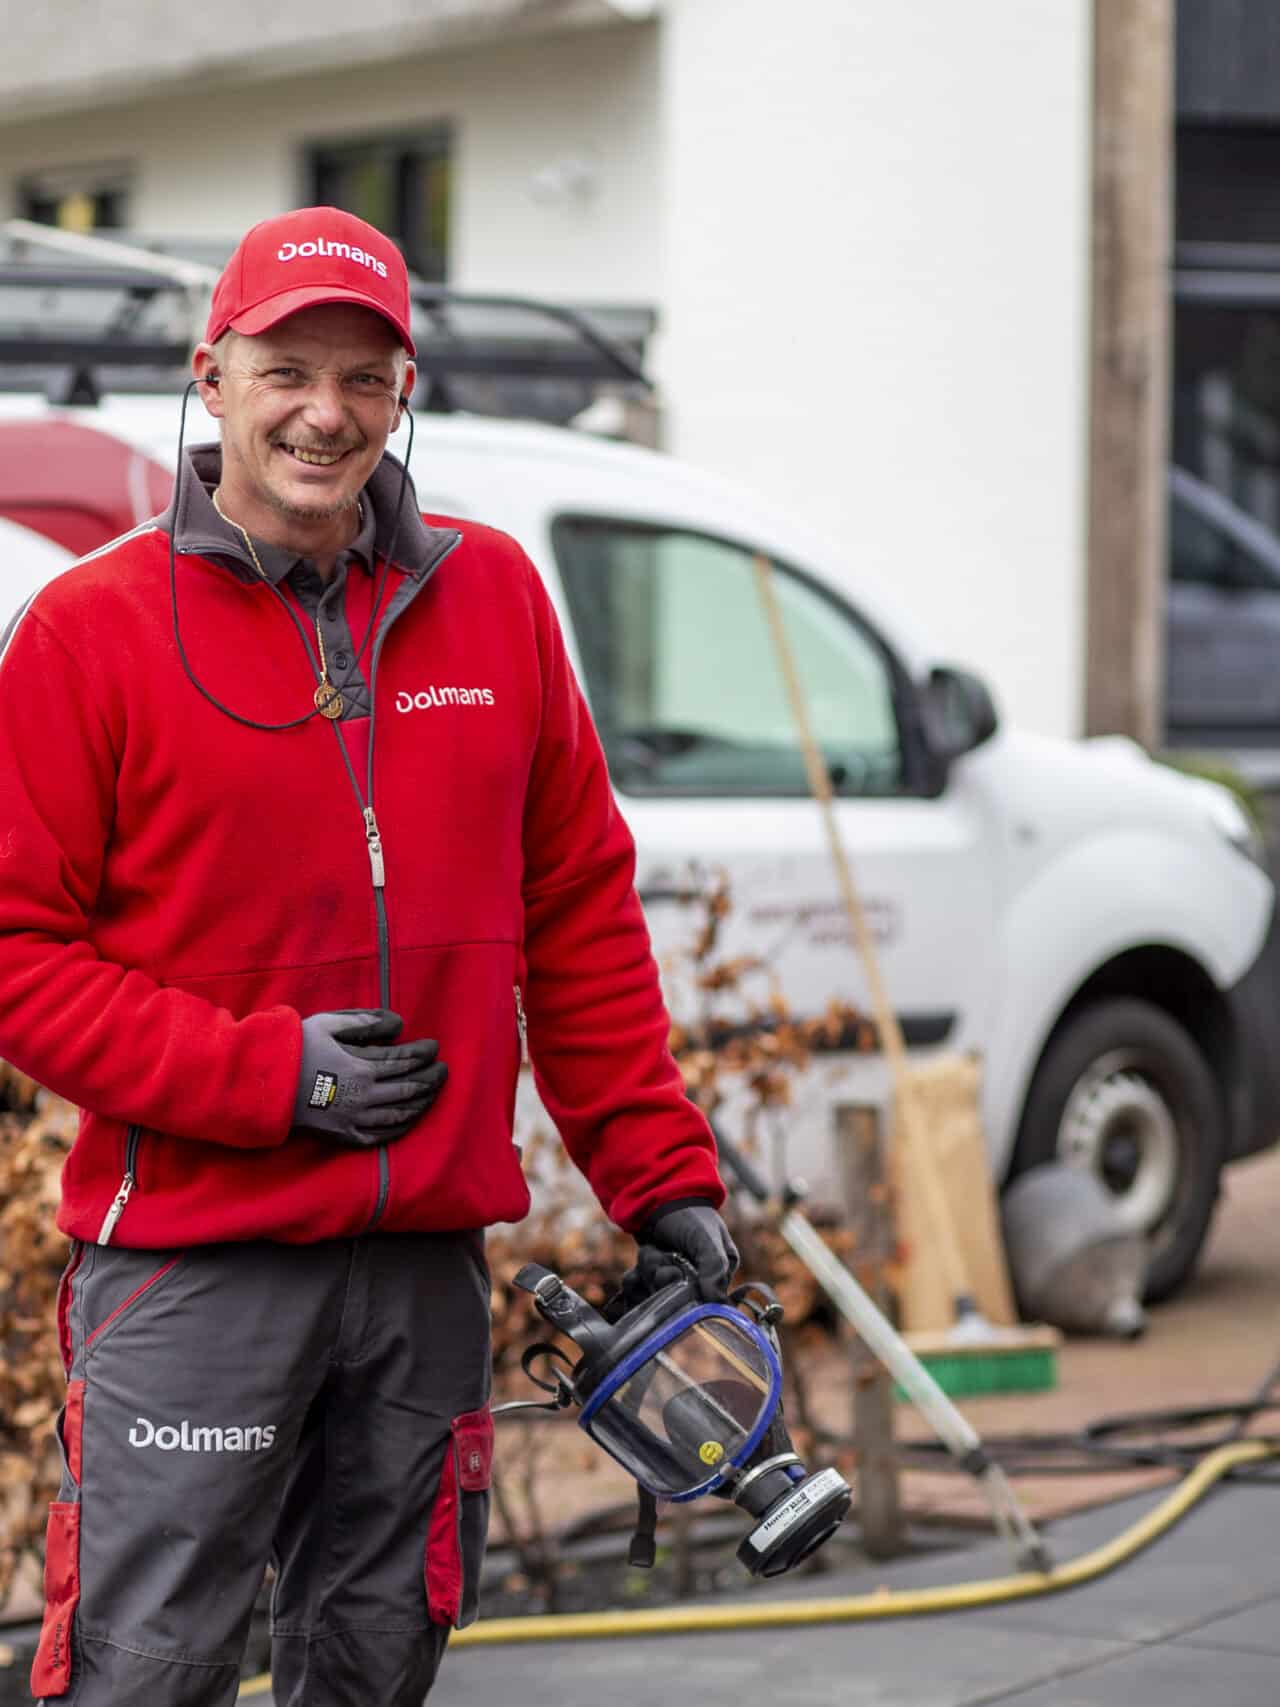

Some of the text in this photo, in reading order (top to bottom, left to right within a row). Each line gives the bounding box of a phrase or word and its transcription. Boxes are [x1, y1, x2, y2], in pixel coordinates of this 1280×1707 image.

[277, 237, 388, 278] Dolmans
[395, 685, 495, 713] Dolmans
[128, 1417, 277, 1452] Dolmans
